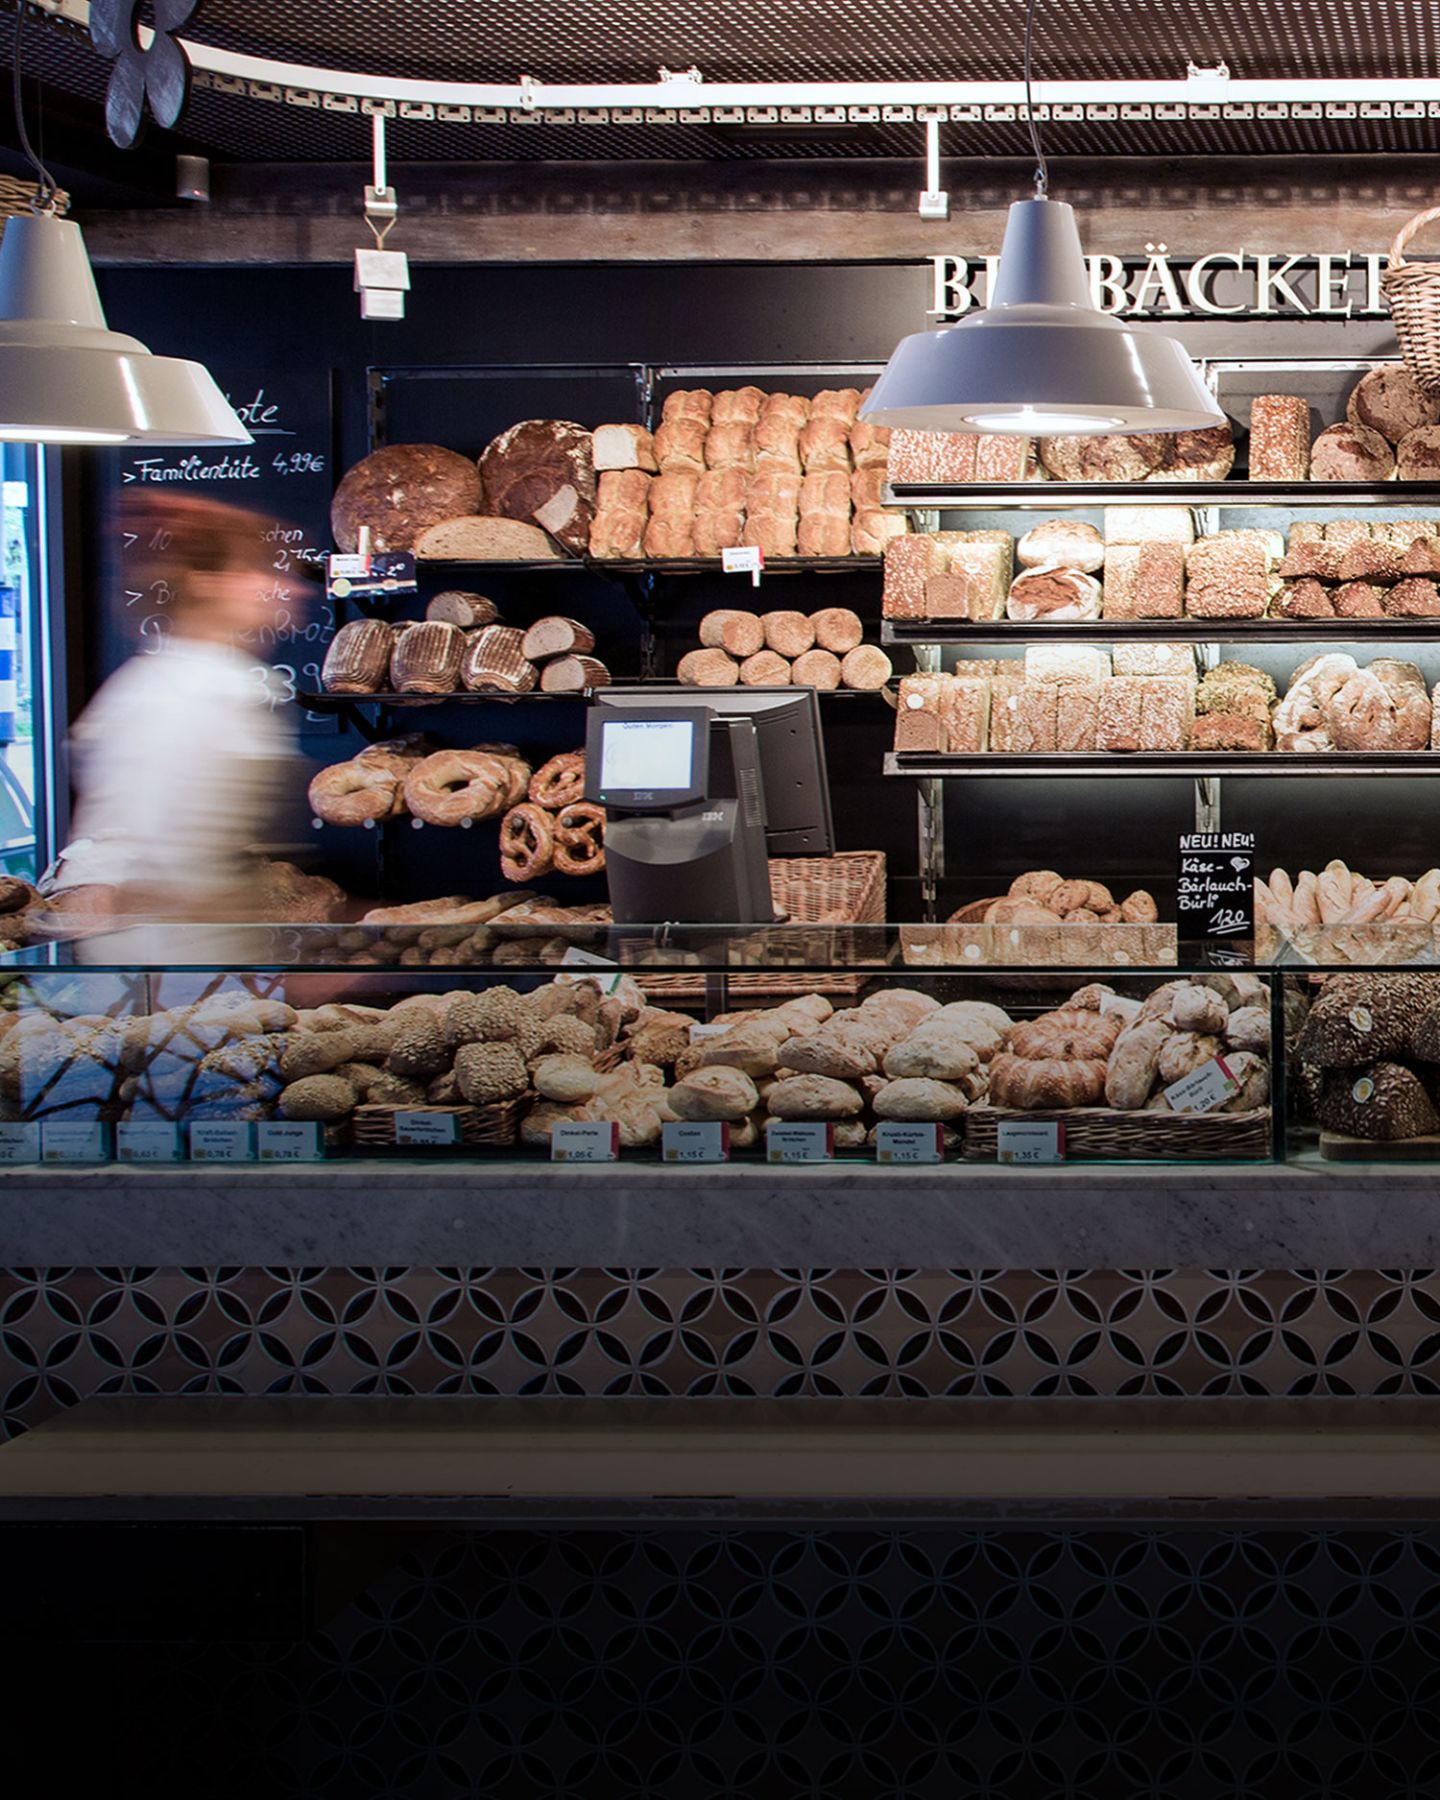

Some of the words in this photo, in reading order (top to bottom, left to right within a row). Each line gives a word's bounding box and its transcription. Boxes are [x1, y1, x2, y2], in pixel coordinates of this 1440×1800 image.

[926, 242, 1392, 317] BIBÄCKE
[133, 455, 260, 481] Familientüte
[1179, 834, 1219, 849] NEU!
